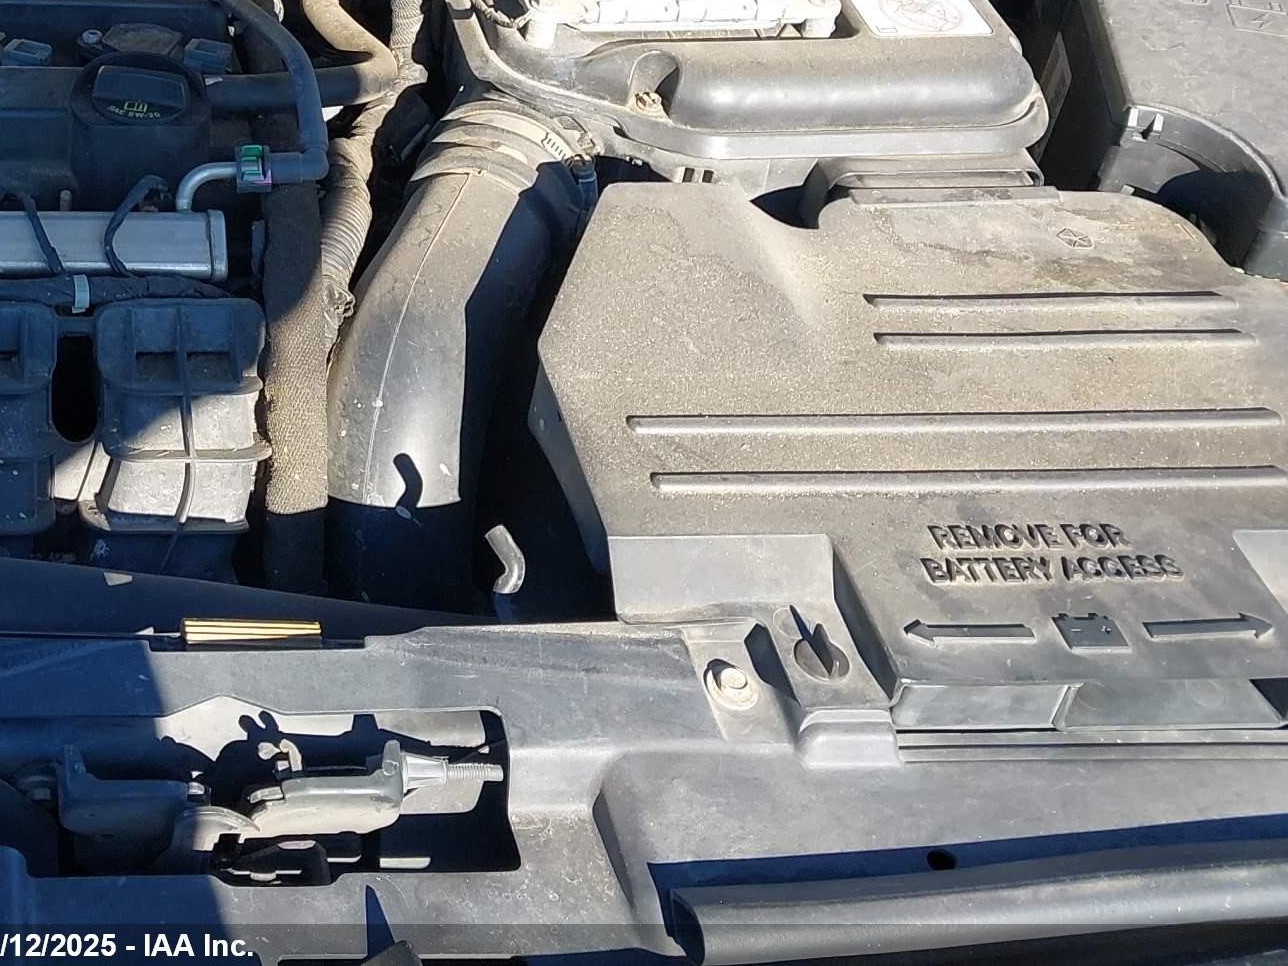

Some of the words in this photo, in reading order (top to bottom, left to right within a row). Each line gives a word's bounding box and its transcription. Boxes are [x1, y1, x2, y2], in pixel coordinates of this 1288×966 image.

[926, 523, 1062, 551] REMOVE
[1062, 523, 1133, 549] FOR
[919, 557, 1054, 584] BATTERY
[1061, 553, 1185, 581] ACCESS
